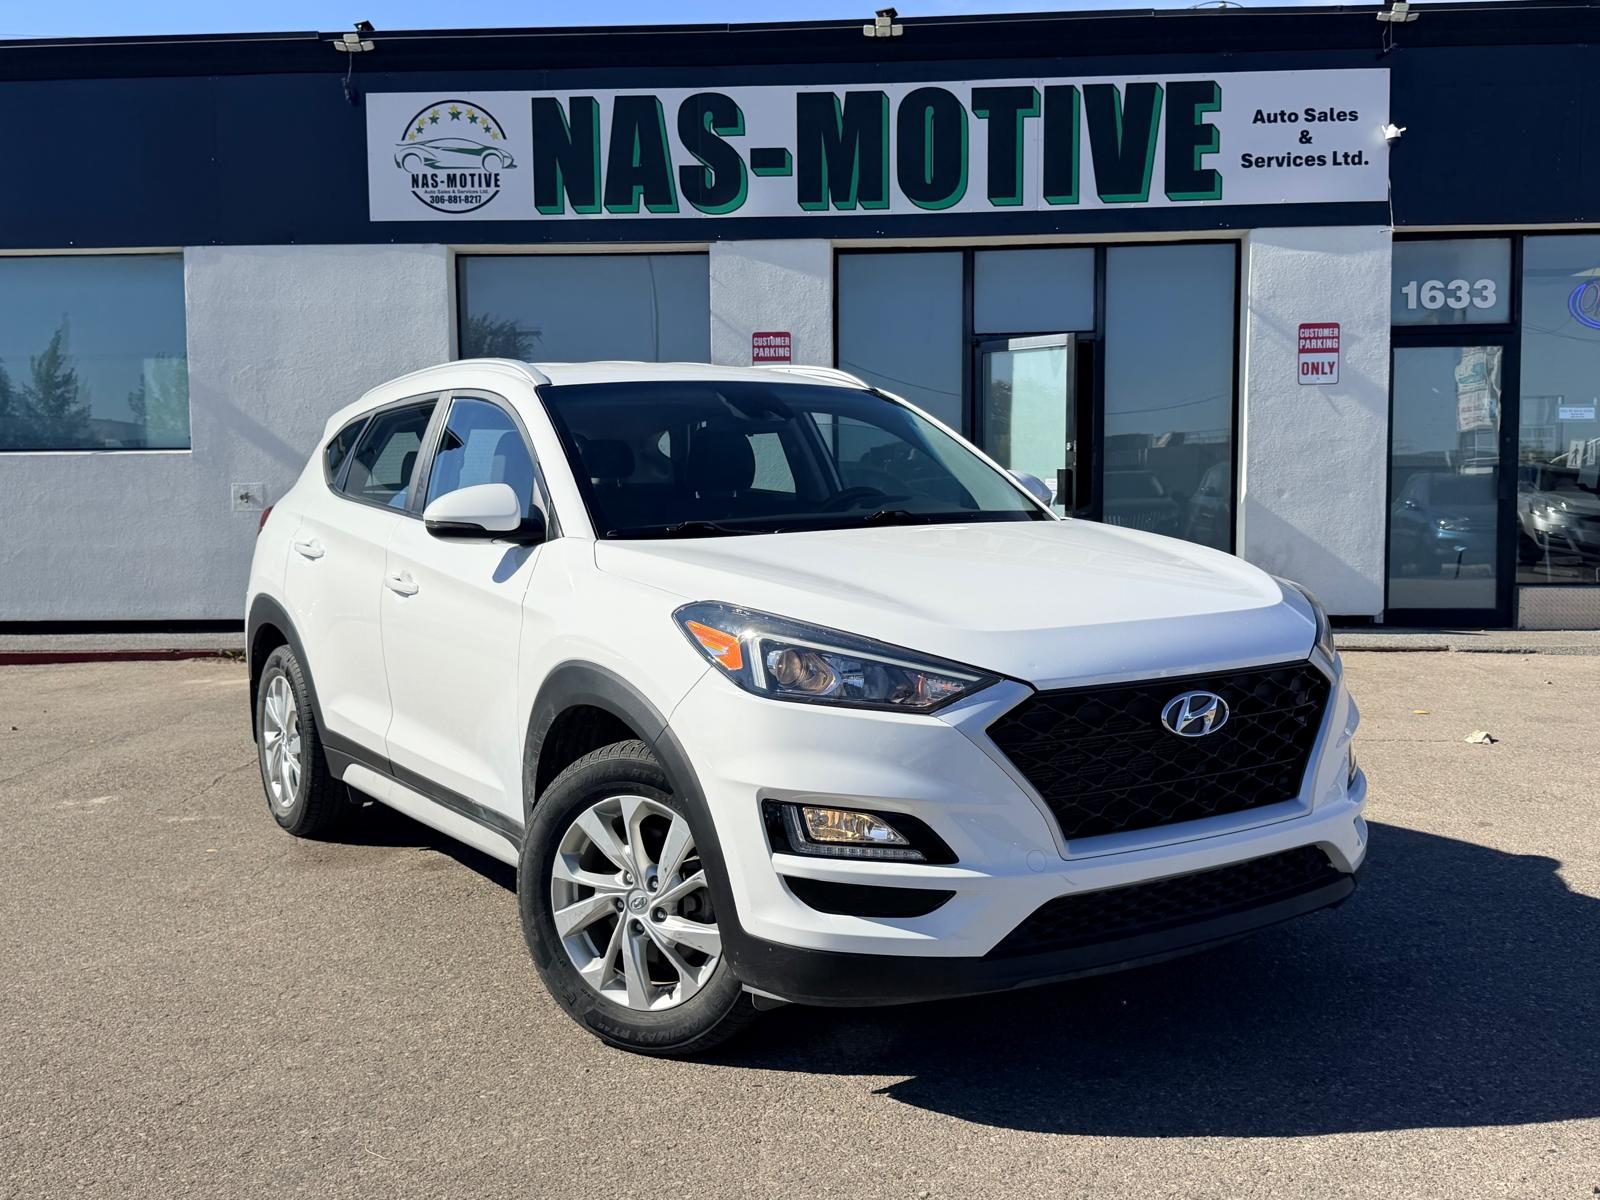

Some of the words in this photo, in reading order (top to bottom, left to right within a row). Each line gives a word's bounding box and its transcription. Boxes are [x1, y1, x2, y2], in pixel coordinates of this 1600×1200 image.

[1252, 109, 1299, 124] Auto
[1304, 107, 1359, 123] Sales
[1298, 129, 1313, 144] &
[531, 80, 1222, 216] NAS-MOTIVE
[1241, 151, 1327, 168] Services
[1332, 150, 1370, 166] Ltd.
[411, 173, 501, 189] NAS-MOTIVE
[429, 195, 482, 204] 306-881-8217
[1401, 279, 1497, 309] 1633
[1300, 328, 1339, 338] CUSTOMER
[753, 336, 790, 346] CUSTOMER
[1300, 339, 1339, 349] PARKING
[753, 347, 790, 357] PARKING
[1301, 361, 1336, 376] ONLY
